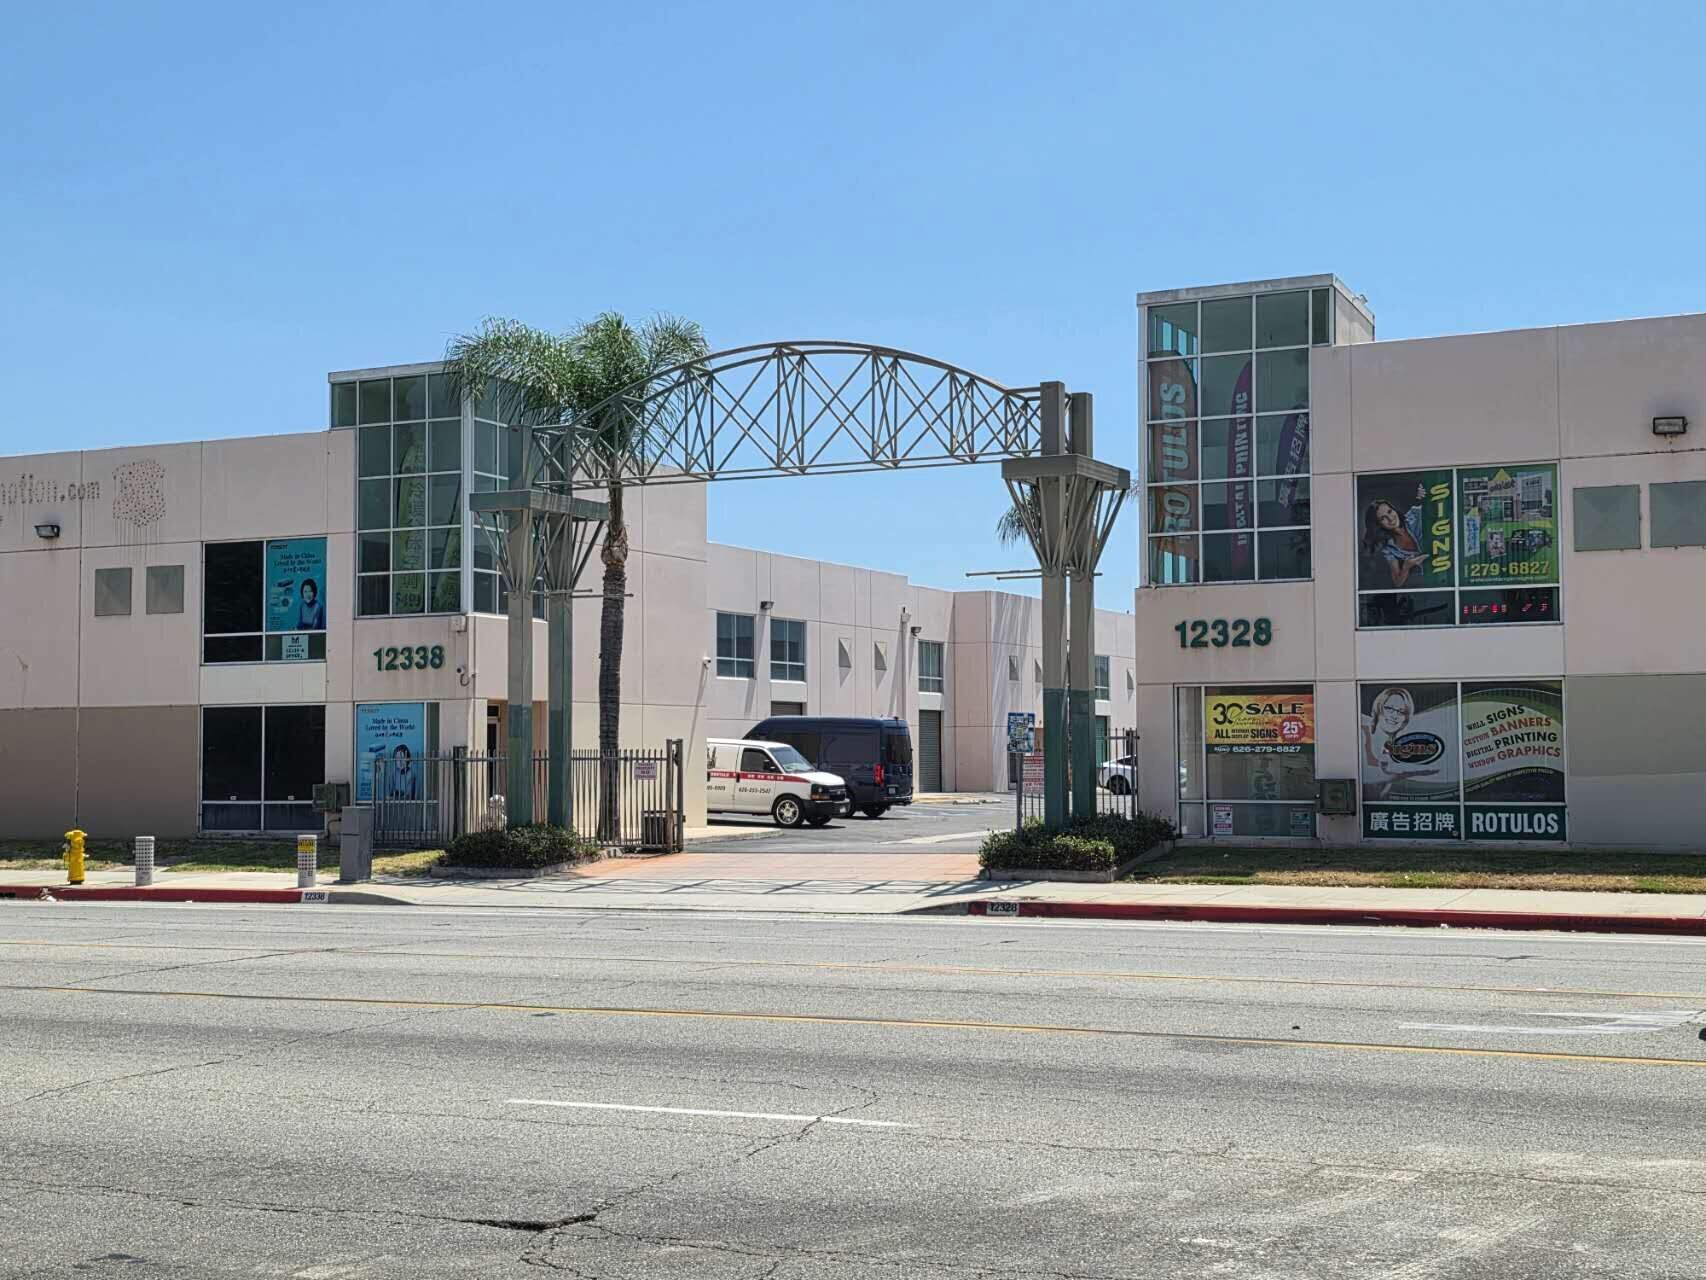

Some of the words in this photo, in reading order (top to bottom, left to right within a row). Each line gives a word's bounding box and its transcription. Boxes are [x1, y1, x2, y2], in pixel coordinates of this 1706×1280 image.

[1158, 382, 1192, 544] ROTULOS
[1430, 482, 1451, 573] SIGNS
[1175, 618, 1272, 648] 12328
[373, 645, 445, 671] 12338
[1245, 703, 1305, 715] SALE
[1486, 705, 1525, 723] SIGNS
[1214, 728, 1231, 739] ALL
[1251, 727, 1278, 739] SIGNS
[1490, 716, 1552, 737] BANNERS
[1494, 731, 1558, 750] PRINTING
[1497, 746, 1561, 762] GRAPHICS
[1370, 812, 1455, 832] 廣告招牌
[1472, 812, 1559, 834] ROTULOS
[990, 902, 1017, 913] 12328
